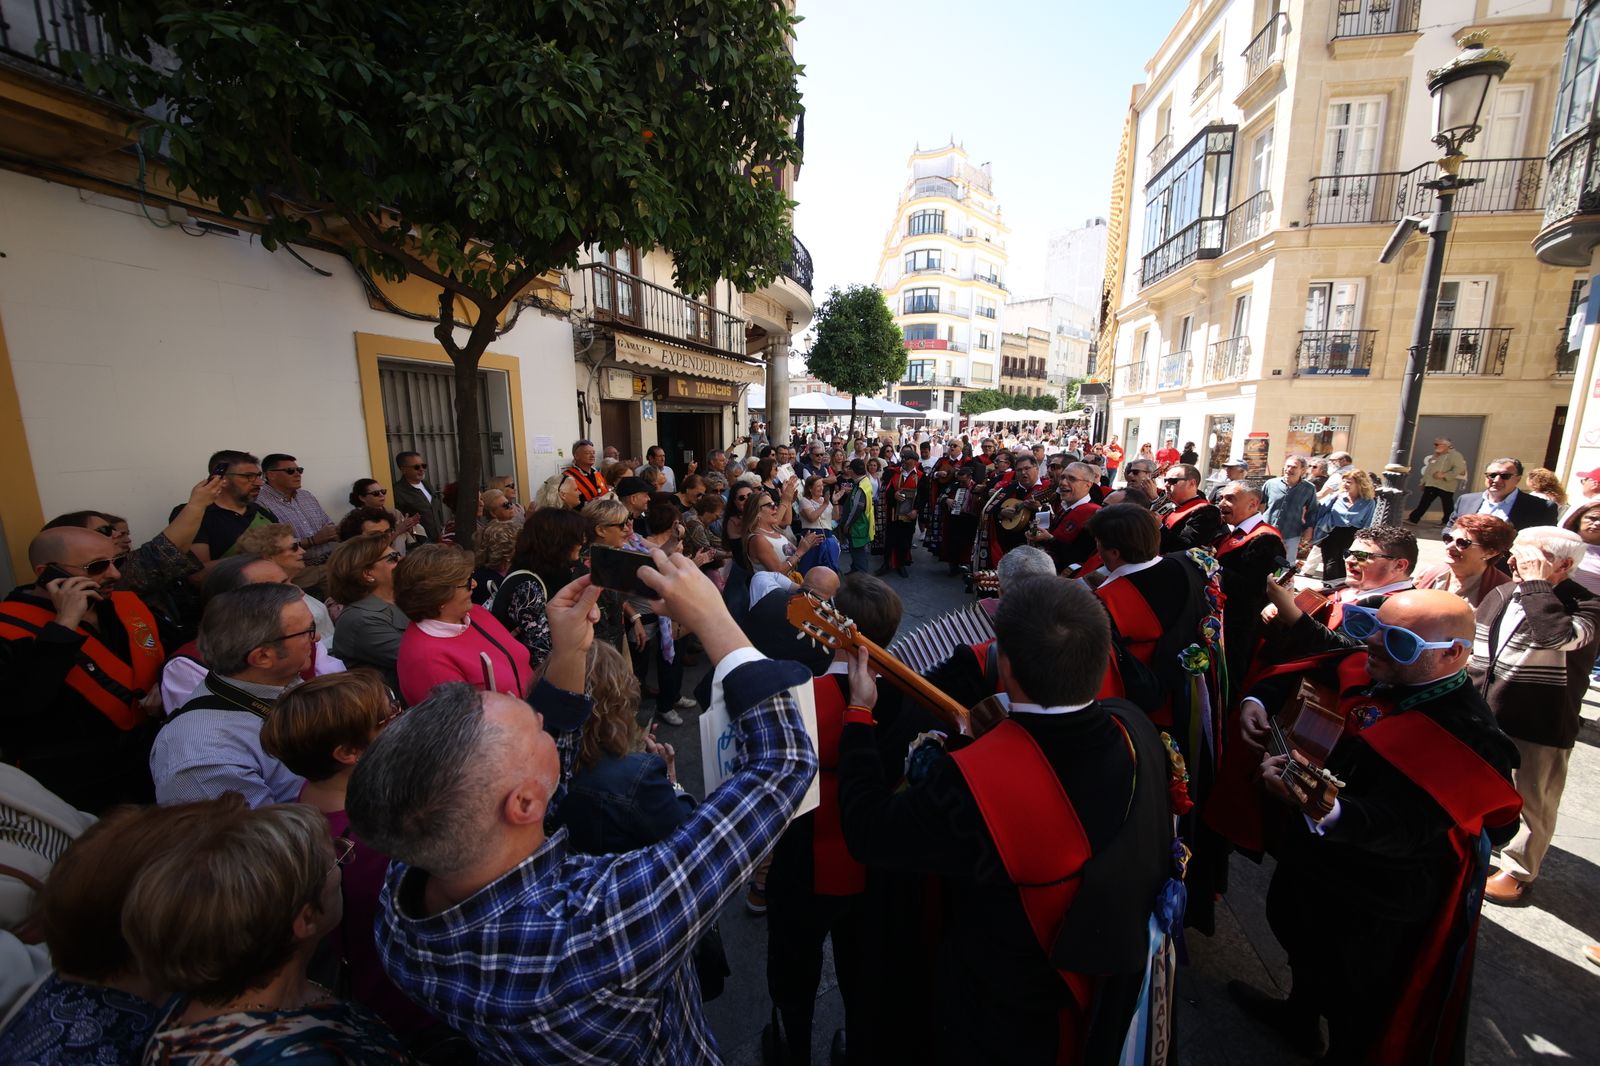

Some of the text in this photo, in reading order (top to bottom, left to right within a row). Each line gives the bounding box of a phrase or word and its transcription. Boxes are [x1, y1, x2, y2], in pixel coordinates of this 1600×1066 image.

[617, 339, 654, 354] GARVEY
[661, 349, 744, 379] EXPENDEDURIA 25
[695, 381, 732, 397] TABACOS
